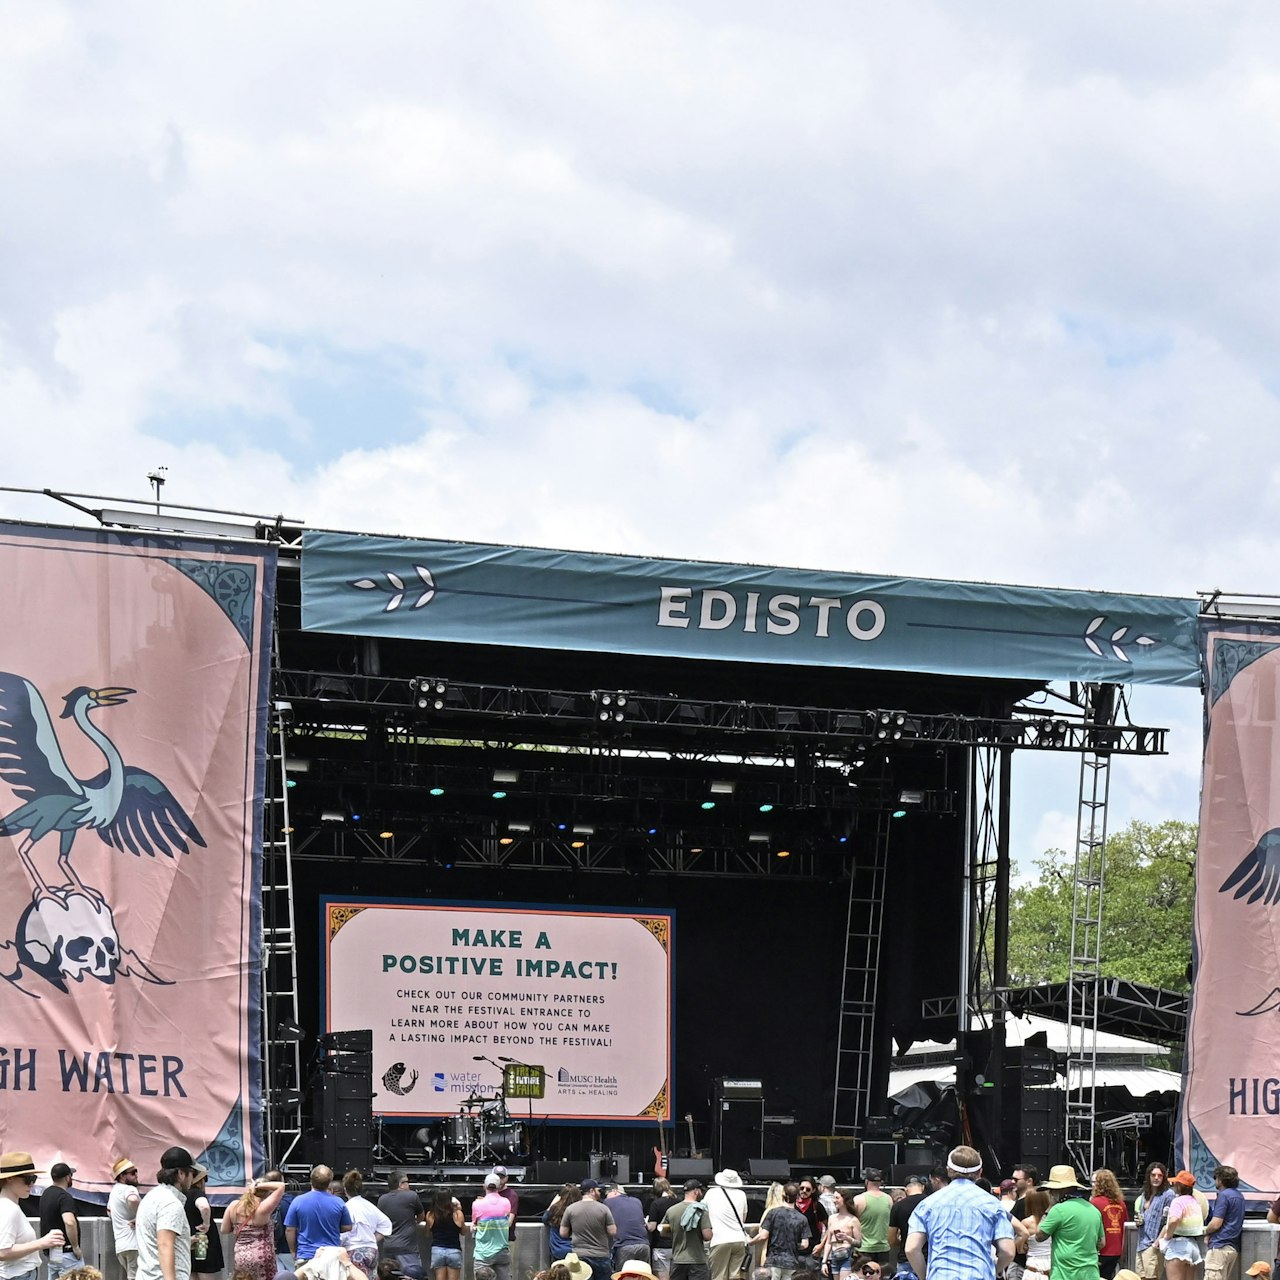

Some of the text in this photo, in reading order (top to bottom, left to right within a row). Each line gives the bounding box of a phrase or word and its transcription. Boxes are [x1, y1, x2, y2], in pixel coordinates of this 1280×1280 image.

[656, 585, 886, 641] EDISTO
[452, 928, 552, 949] MAKE A
[382, 954, 618, 980] POSITIVE IMPACT!
[396, 989, 605, 1004] CHECK OUT OUR COMMUNITY PARTNERS
[411, 1004, 591, 1018] NEAR THE FESTIVAL ENTRANCE TO
[391, 1018, 610, 1033] LEARN MORE ABOUT HOW YOU CAN MAKE
[389, 1033, 612, 1047] A LASTING IMPACT BEYOND THE FESTIVAL!
[58, 1049, 188, 1098] WATER
[450, 1072, 482, 1082] water
[570, 1075, 618, 1084] MUSC Health
[450, 1081, 494, 1093] mission
